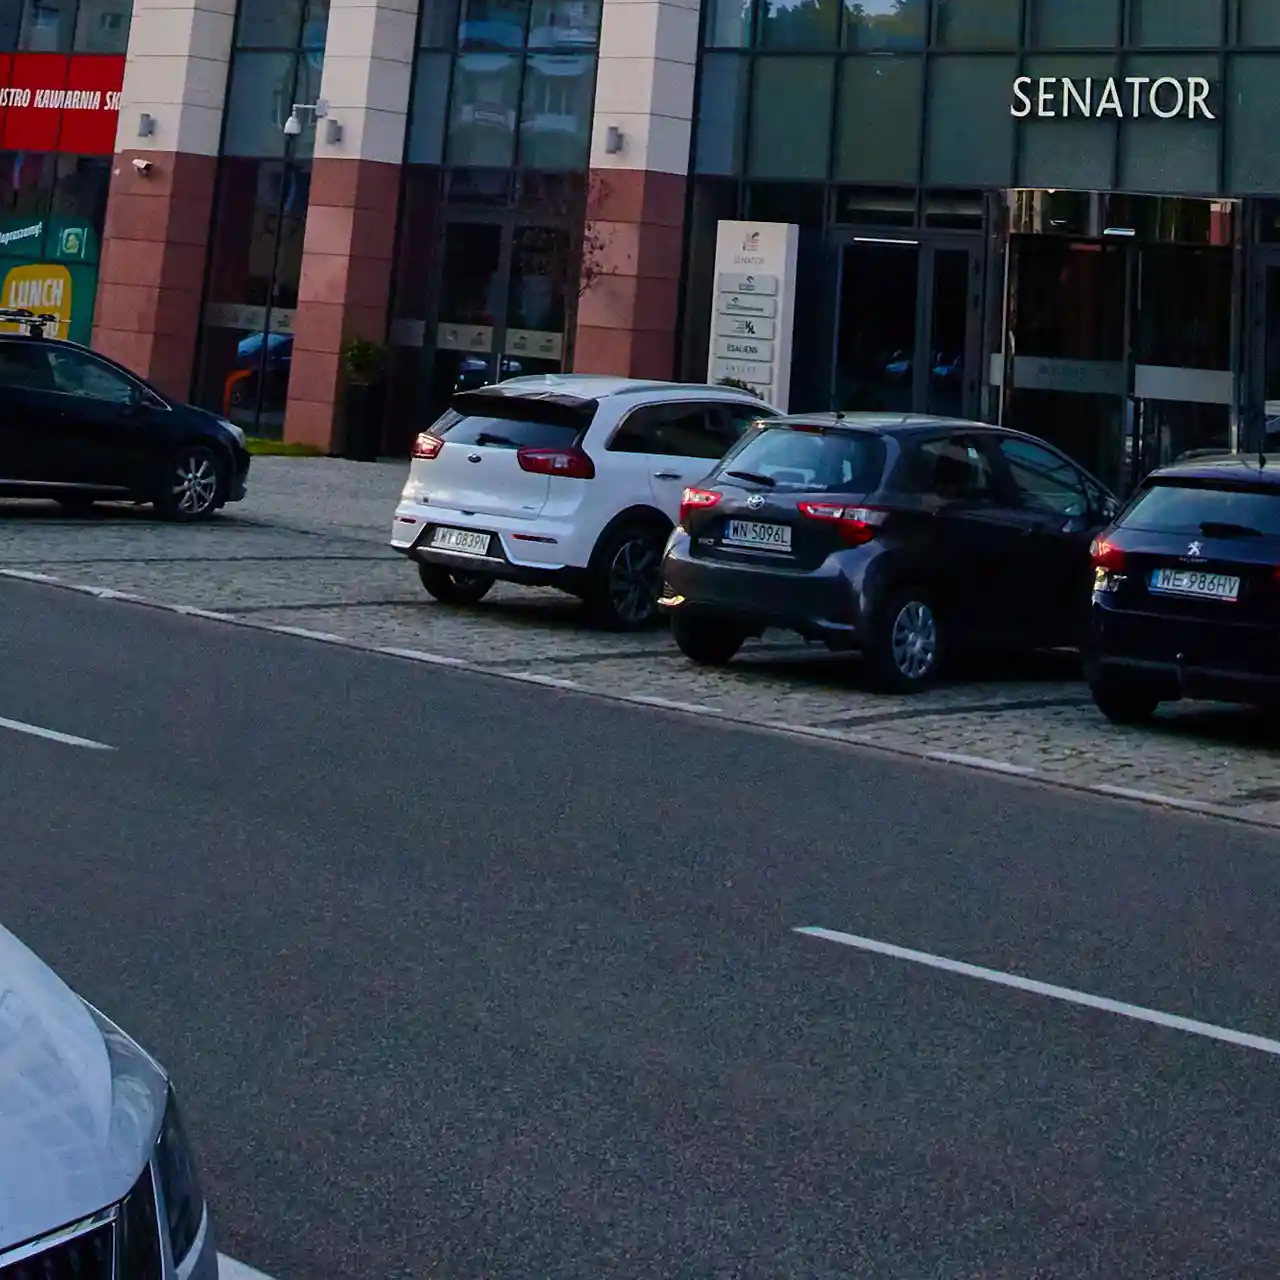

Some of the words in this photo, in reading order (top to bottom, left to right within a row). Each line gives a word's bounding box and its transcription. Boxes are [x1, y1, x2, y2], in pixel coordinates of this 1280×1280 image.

[33, 89, 101, 110] KAWIARNIA
[103, 91, 121, 111] SK
[1010, 76, 1216, 120] SENATOR
[8, 278, 64, 308] LUNCH
[732, 520, 748, 538] WN
[751, 524, 789, 544] 5096L
[1188, 573, 1238, 594] 986HV
